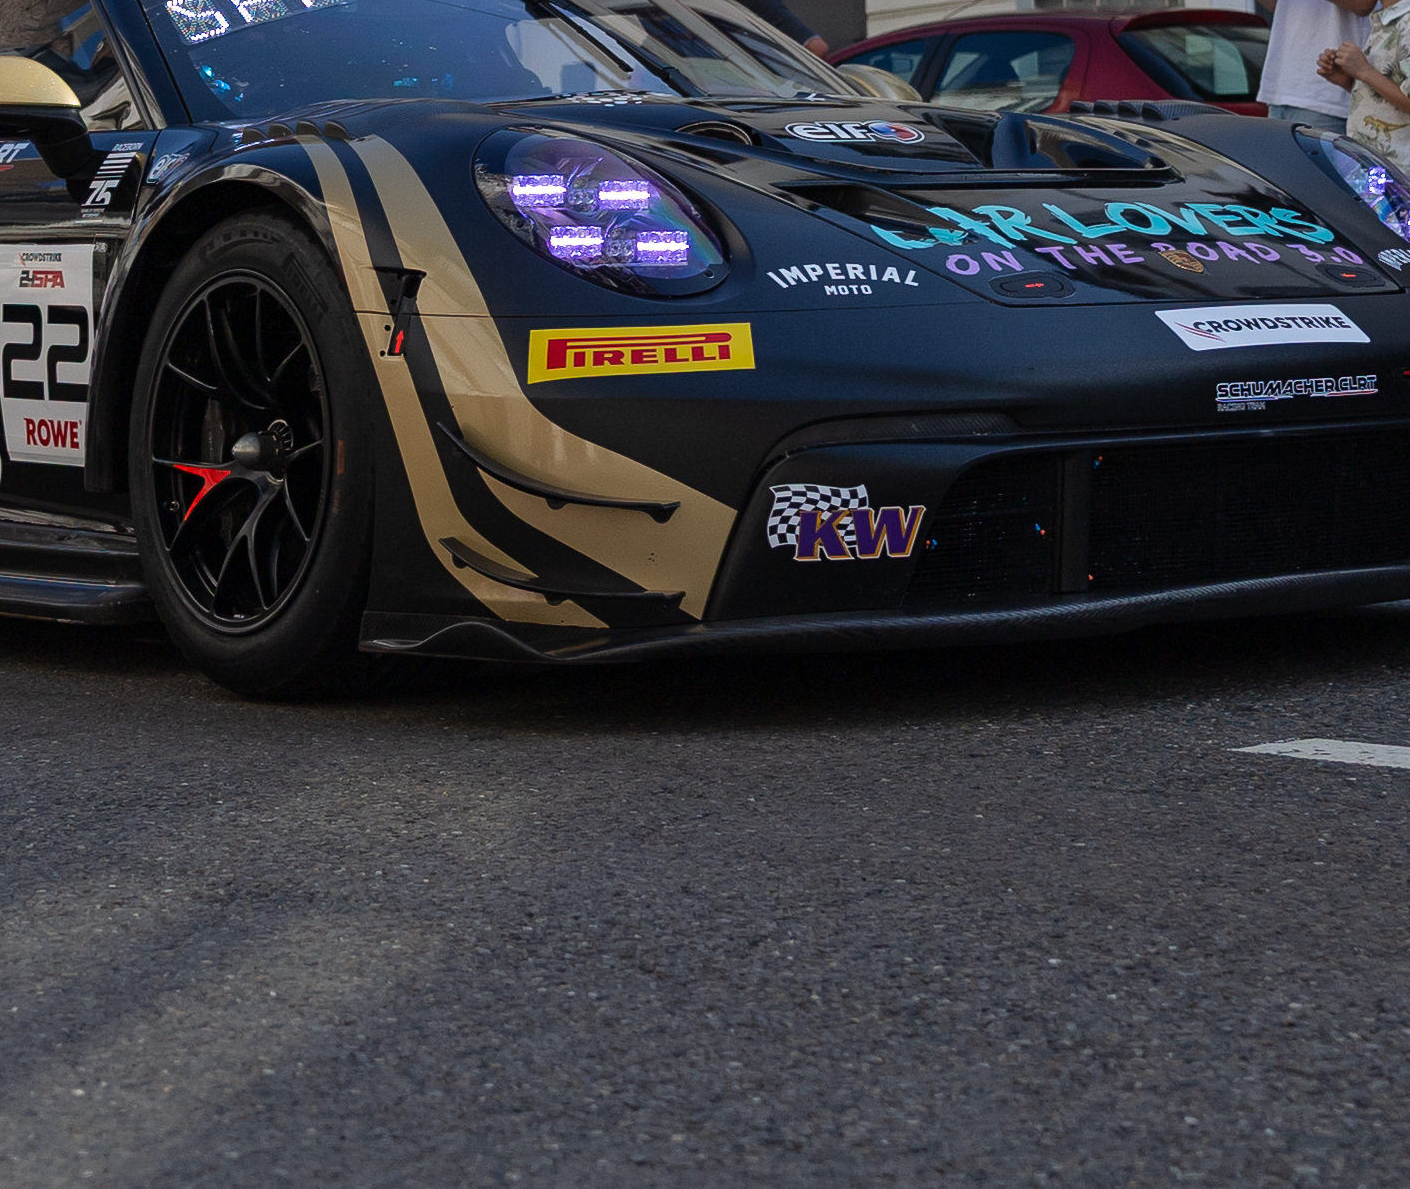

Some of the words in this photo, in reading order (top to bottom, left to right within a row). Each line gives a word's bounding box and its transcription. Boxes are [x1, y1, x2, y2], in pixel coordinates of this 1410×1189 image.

[1042, 202, 1334, 244] LOVERS
[21, 252, 62, 262] CROWDSTRIKE
[945, 250, 1024, 275] ON
[1034, 243, 1145, 270] THE
[1286, 243, 1364, 265] 3.0
[767, 263, 920, 289] IMPERIAL
[824, 284, 873, 296] MOTO
[1192, 316, 1352, 335] CROWDSTRIKE
[1, 303, 89, 403] 22
[546, 332, 732, 371] PIRELLI
[1216, 377, 1337, 399] SCHUMACHER
[1337, 375, 1377, 392] CLRT
[24, 418, 80, 449] ROWE
[793, 505, 926, 561] KW
